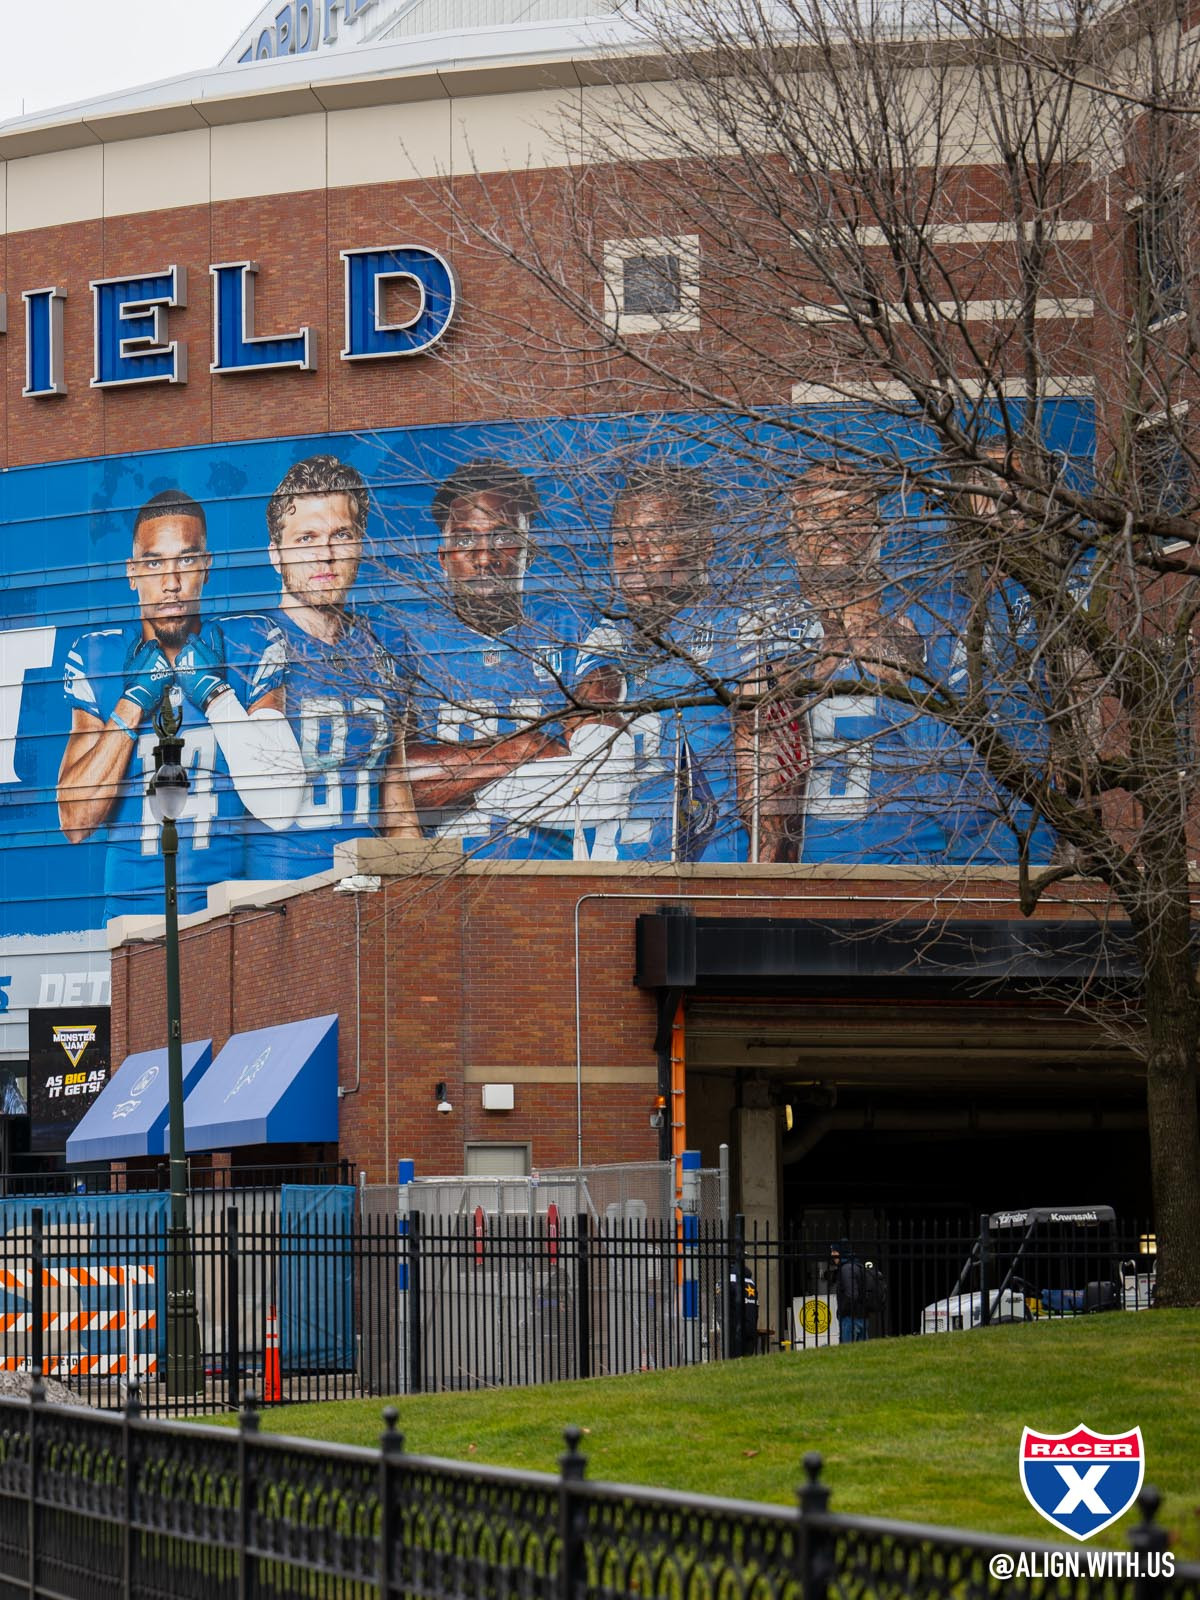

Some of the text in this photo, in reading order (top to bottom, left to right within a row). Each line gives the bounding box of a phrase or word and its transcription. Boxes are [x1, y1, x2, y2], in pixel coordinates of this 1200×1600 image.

[53, 1033, 96, 1042] MONSTER
[64, 1041, 85, 1050] JAM
[46, 1069, 106, 1088] AS BIG AS
[49, 1082, 100, 1098] IT GETS!
[1051, 1211, 1097, 1221] Kawasaki
